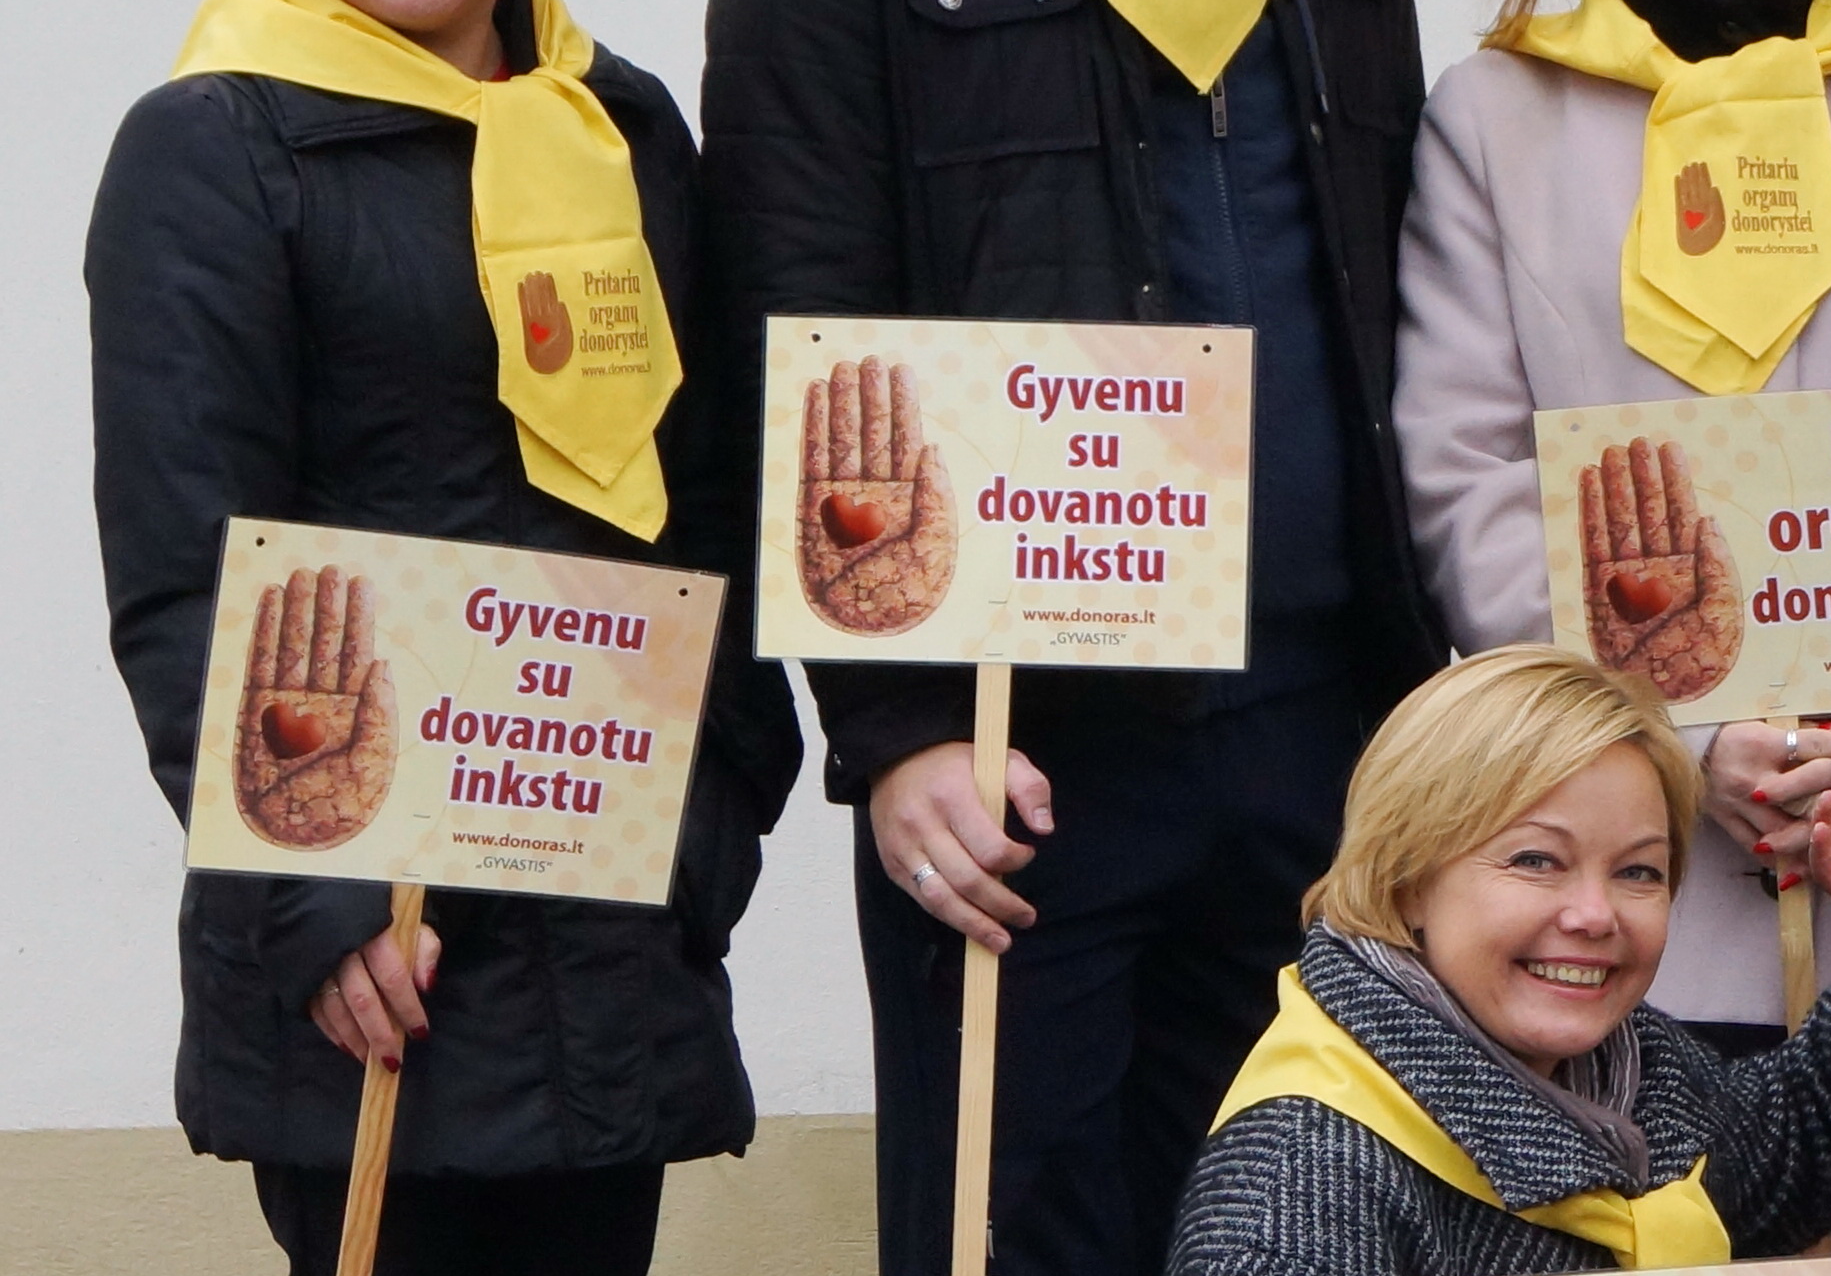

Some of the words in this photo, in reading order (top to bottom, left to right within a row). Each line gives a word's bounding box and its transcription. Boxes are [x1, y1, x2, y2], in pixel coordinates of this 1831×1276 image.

[1736, 156, 1798, 180] Pritariu
[1732, 209, 1814, 238] donorystei
[582, 268, 641, 297] Pritariu
[580, 325, 648, 357] donorystei
[1008, 365, 1182, 422] Gyvenu
[1069, 435, 1118, 467] su
[978, 477, 1205, 526] dovanotu
[1017, 533, 1164, 582] inkstu
[466, 588, 645, 650] Gyvenu
[1023, 608, 1155, 624] www.donoras.lt
[518, 662, 571, 697] su
[421, 697, 651, 764] dovanotu
[451, 755, 601, 813] inkstu
[453, 833, 584, 854] www.donoras.lt
